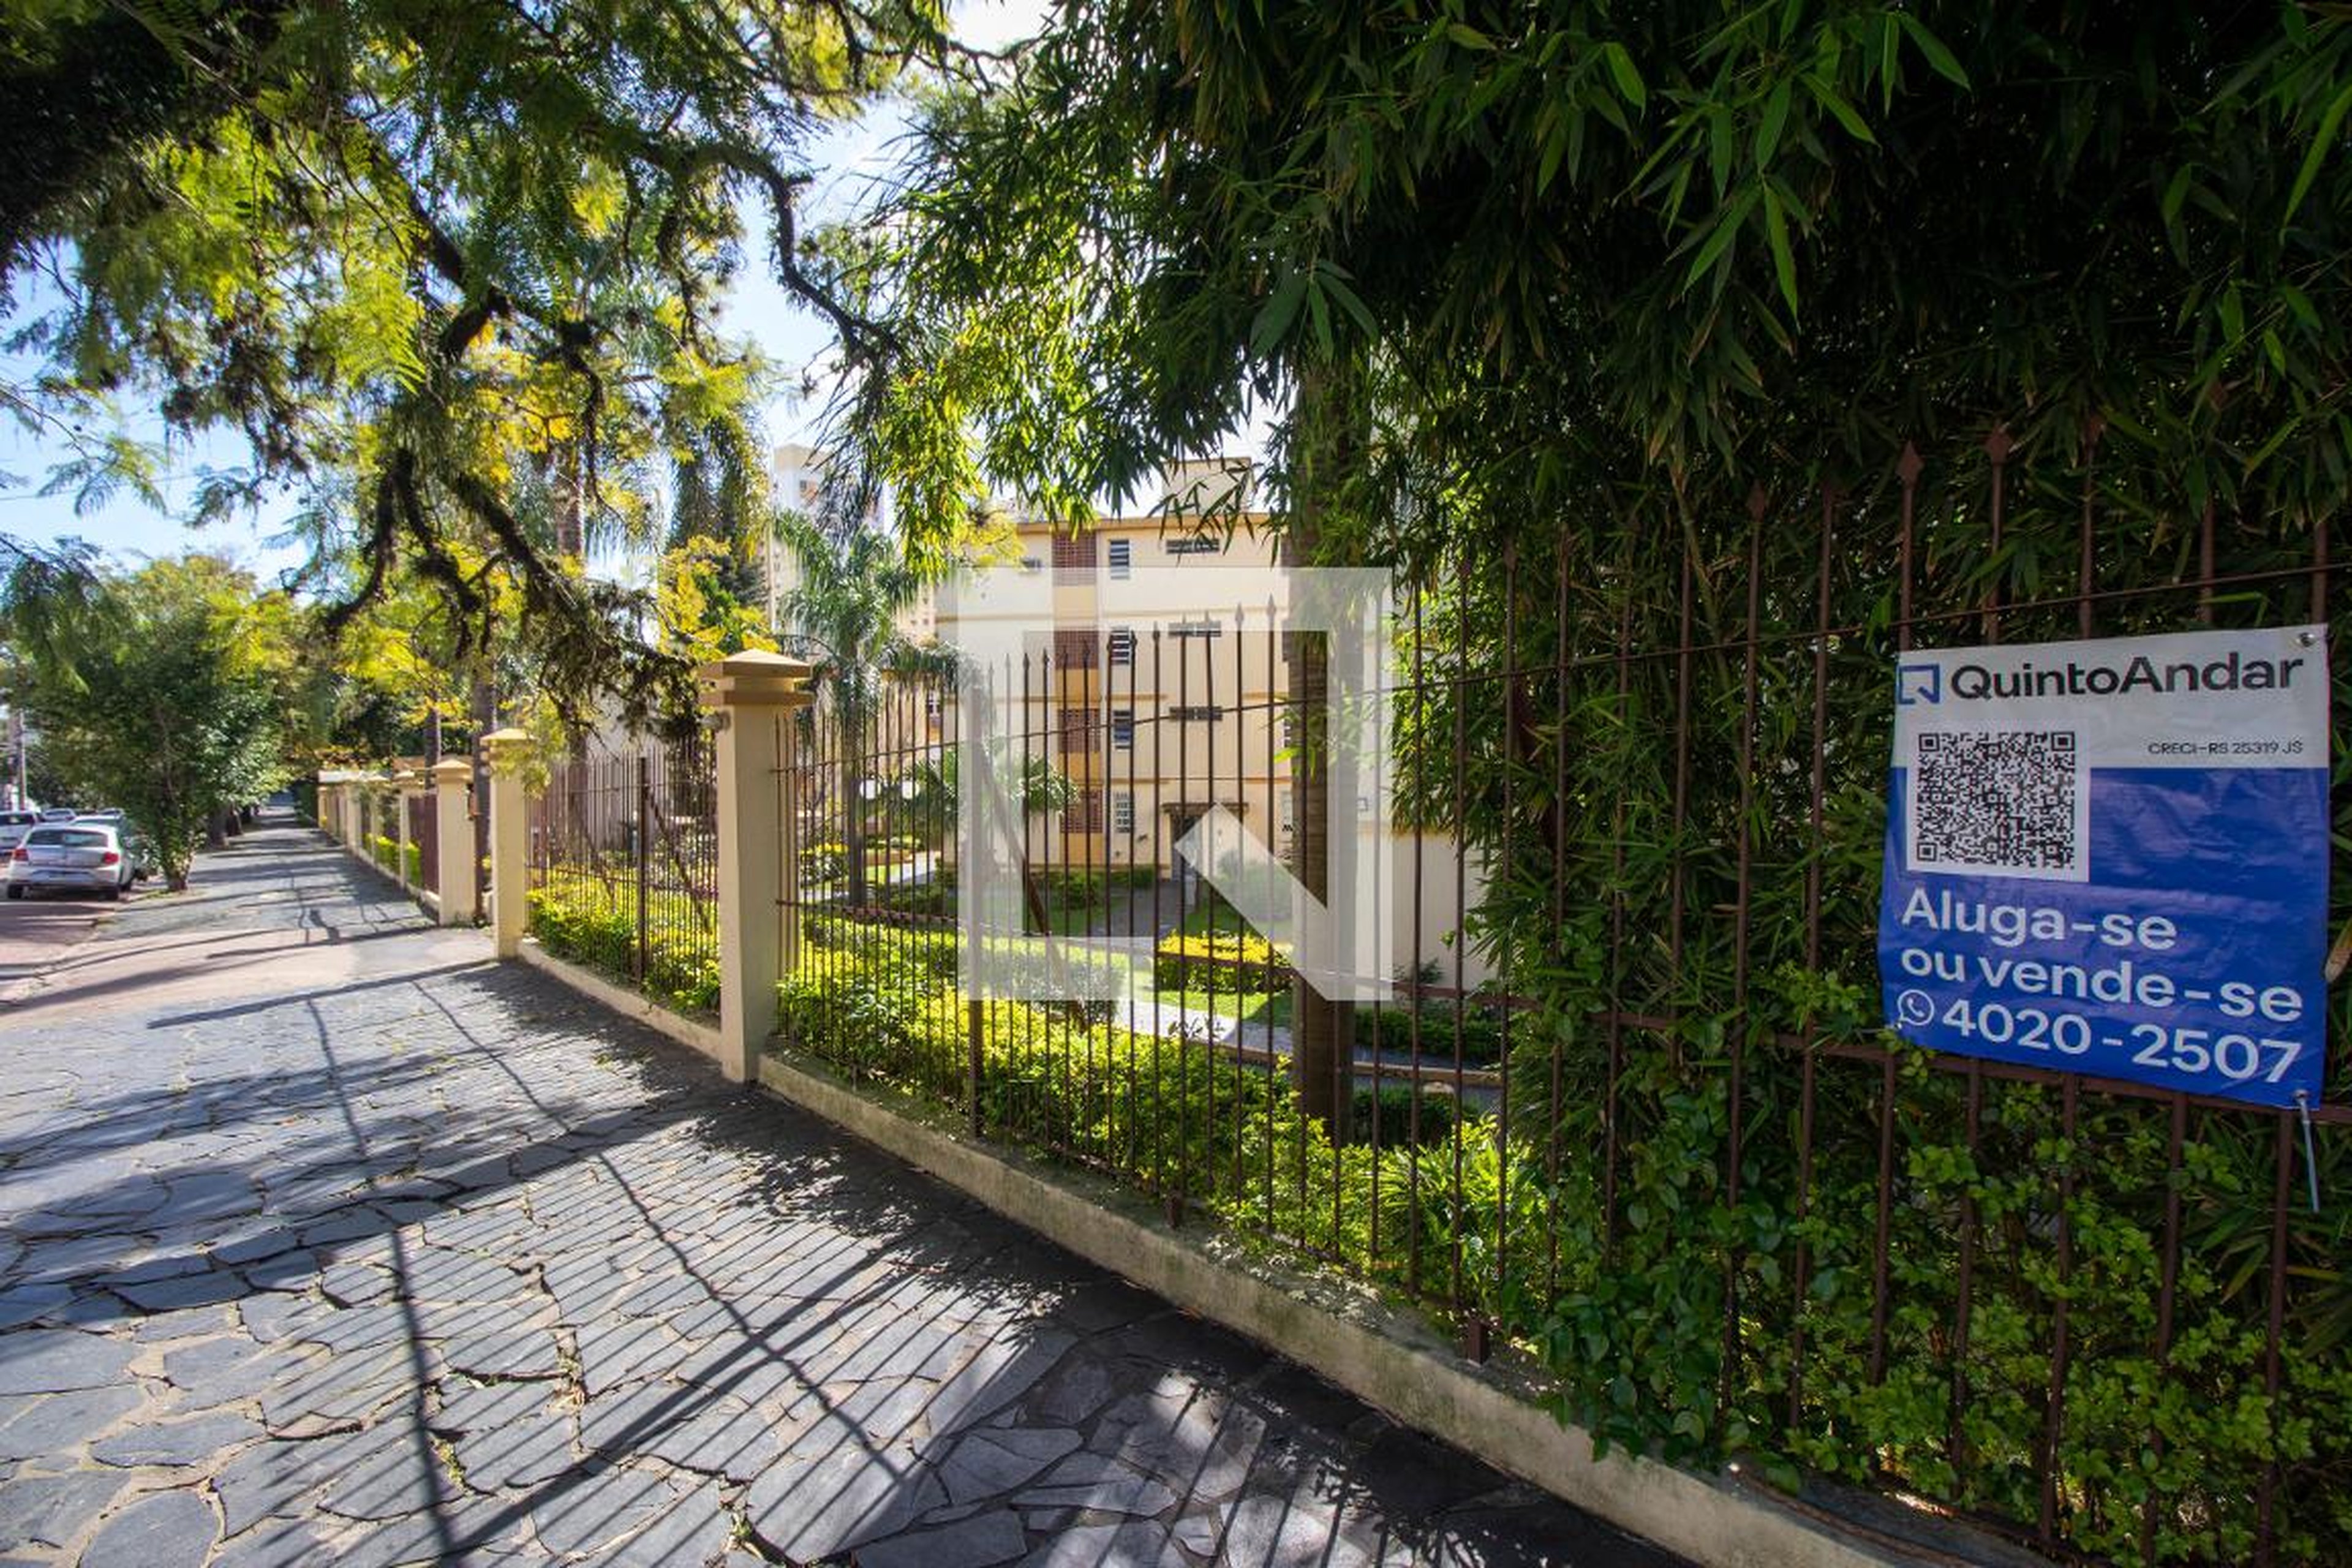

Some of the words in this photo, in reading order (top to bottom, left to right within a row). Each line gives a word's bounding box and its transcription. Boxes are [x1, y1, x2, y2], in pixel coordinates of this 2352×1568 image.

[1951, 652, 2303, 699] QuintoAndar
[2282, 741, 2303, 754] JS
[1902, 888, 2177, 949] Aluga-se
[1902, 948, 1964, 982] ou
[1978, 956, 2303, 1022] vende-se
